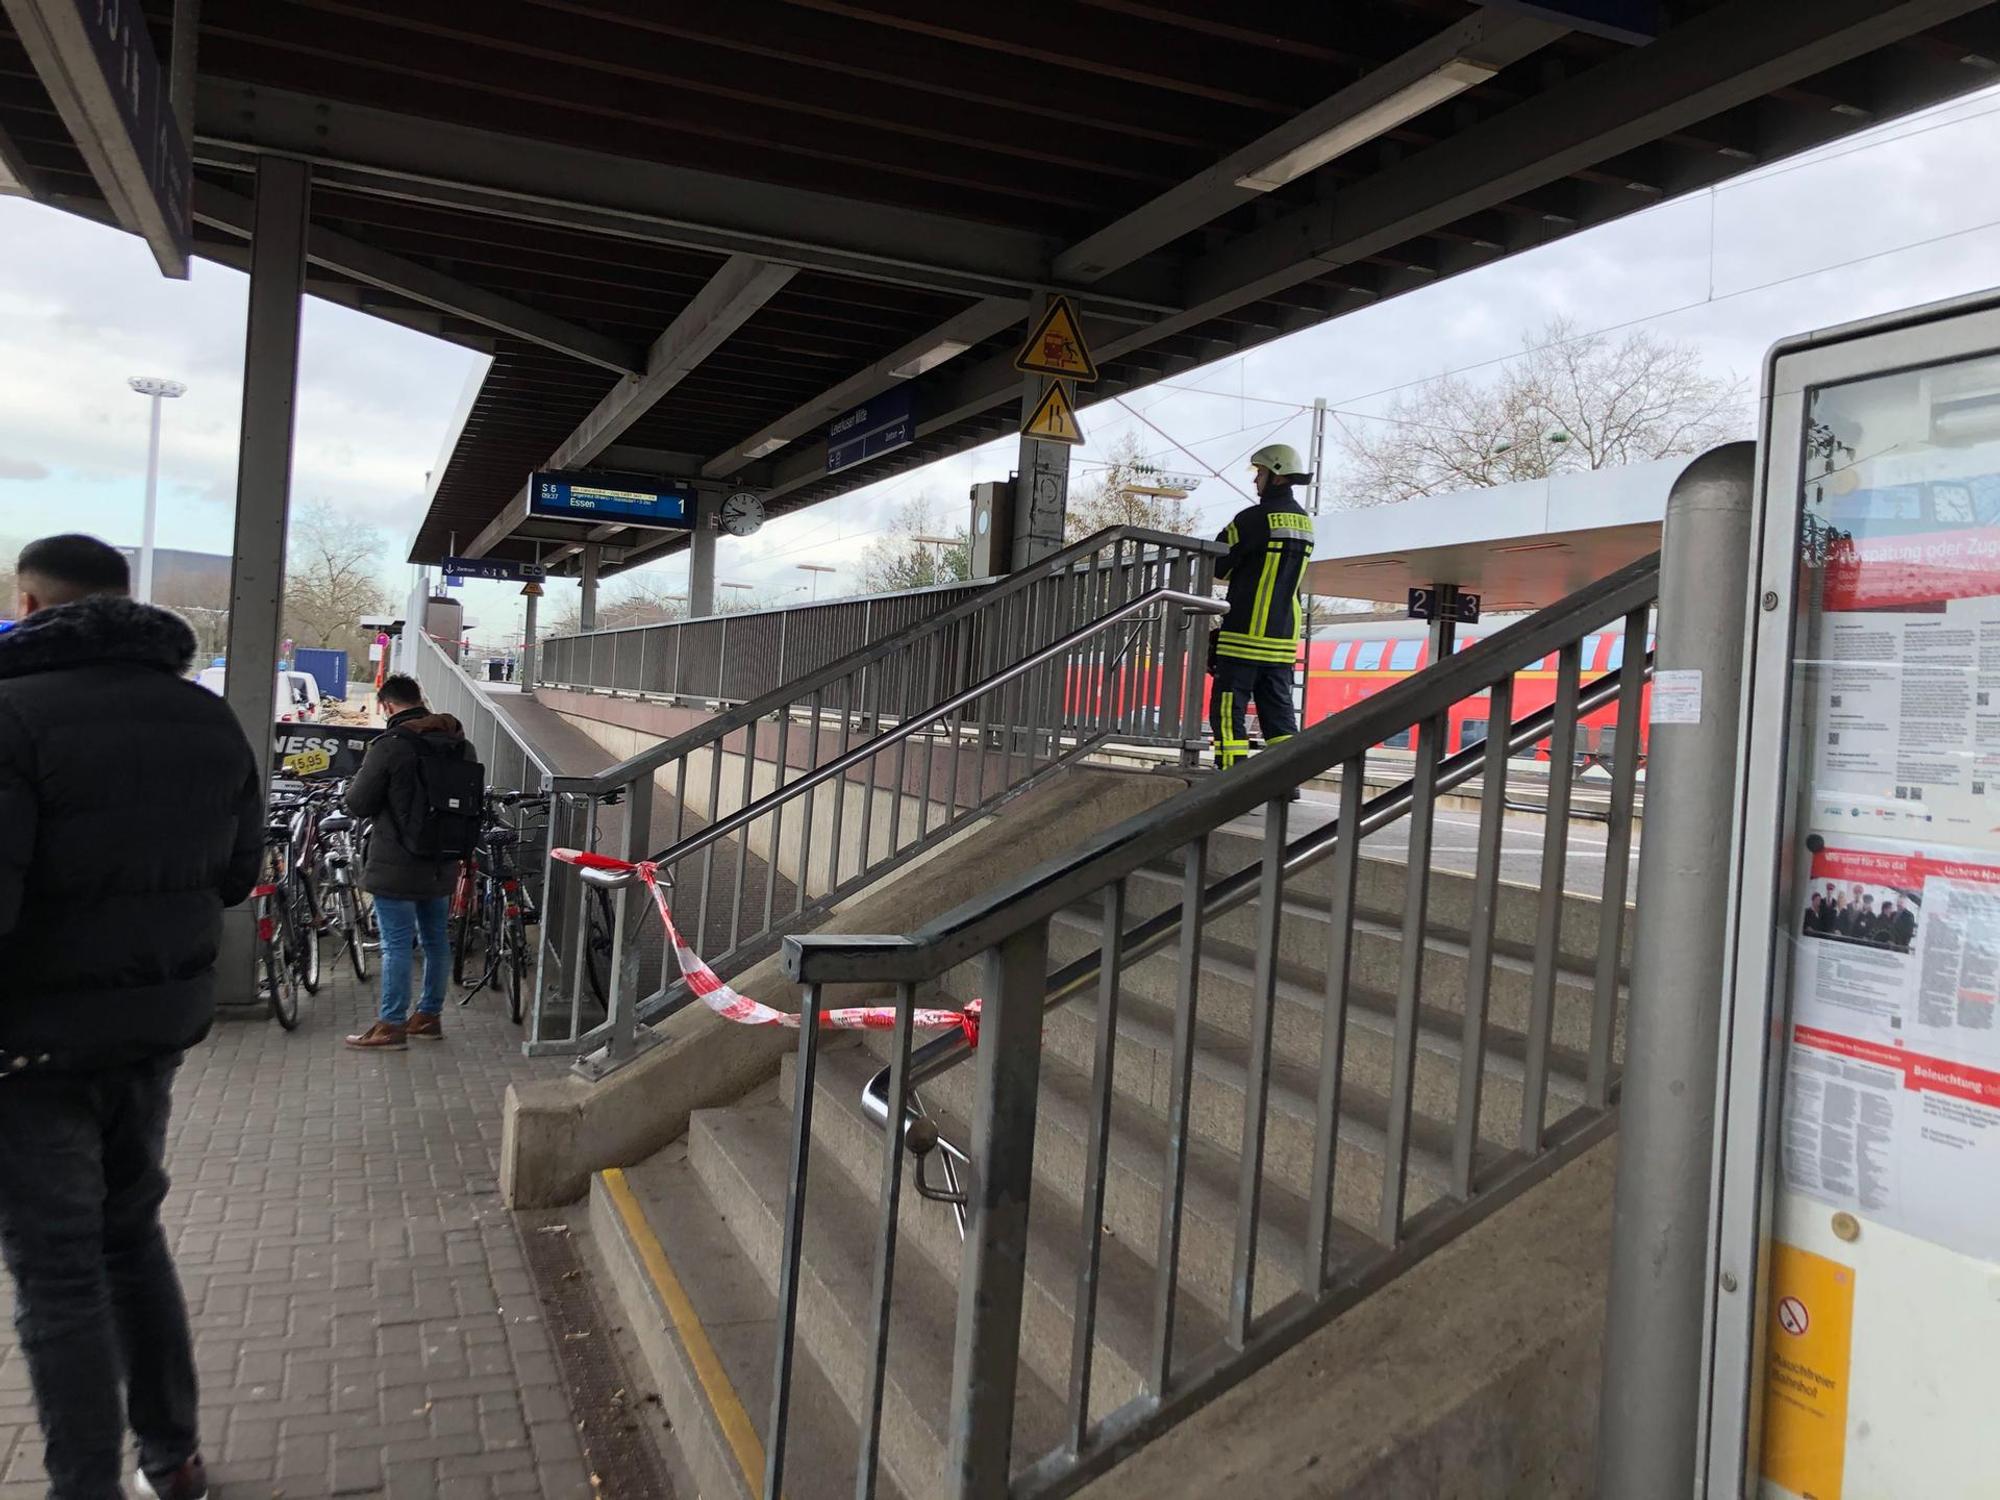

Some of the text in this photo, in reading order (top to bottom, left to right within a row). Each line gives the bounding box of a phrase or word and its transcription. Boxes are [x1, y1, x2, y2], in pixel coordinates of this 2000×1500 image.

[542, 483, 549, 492] S
[570, 497, 595, 508] Essen
[678, 499, 685, 514] 1
[1413, 590, 1428, 615] 2
[1464, 595, 1477, 615] 3
[1913, 1064, 1983, 1095] Beleuchtung
